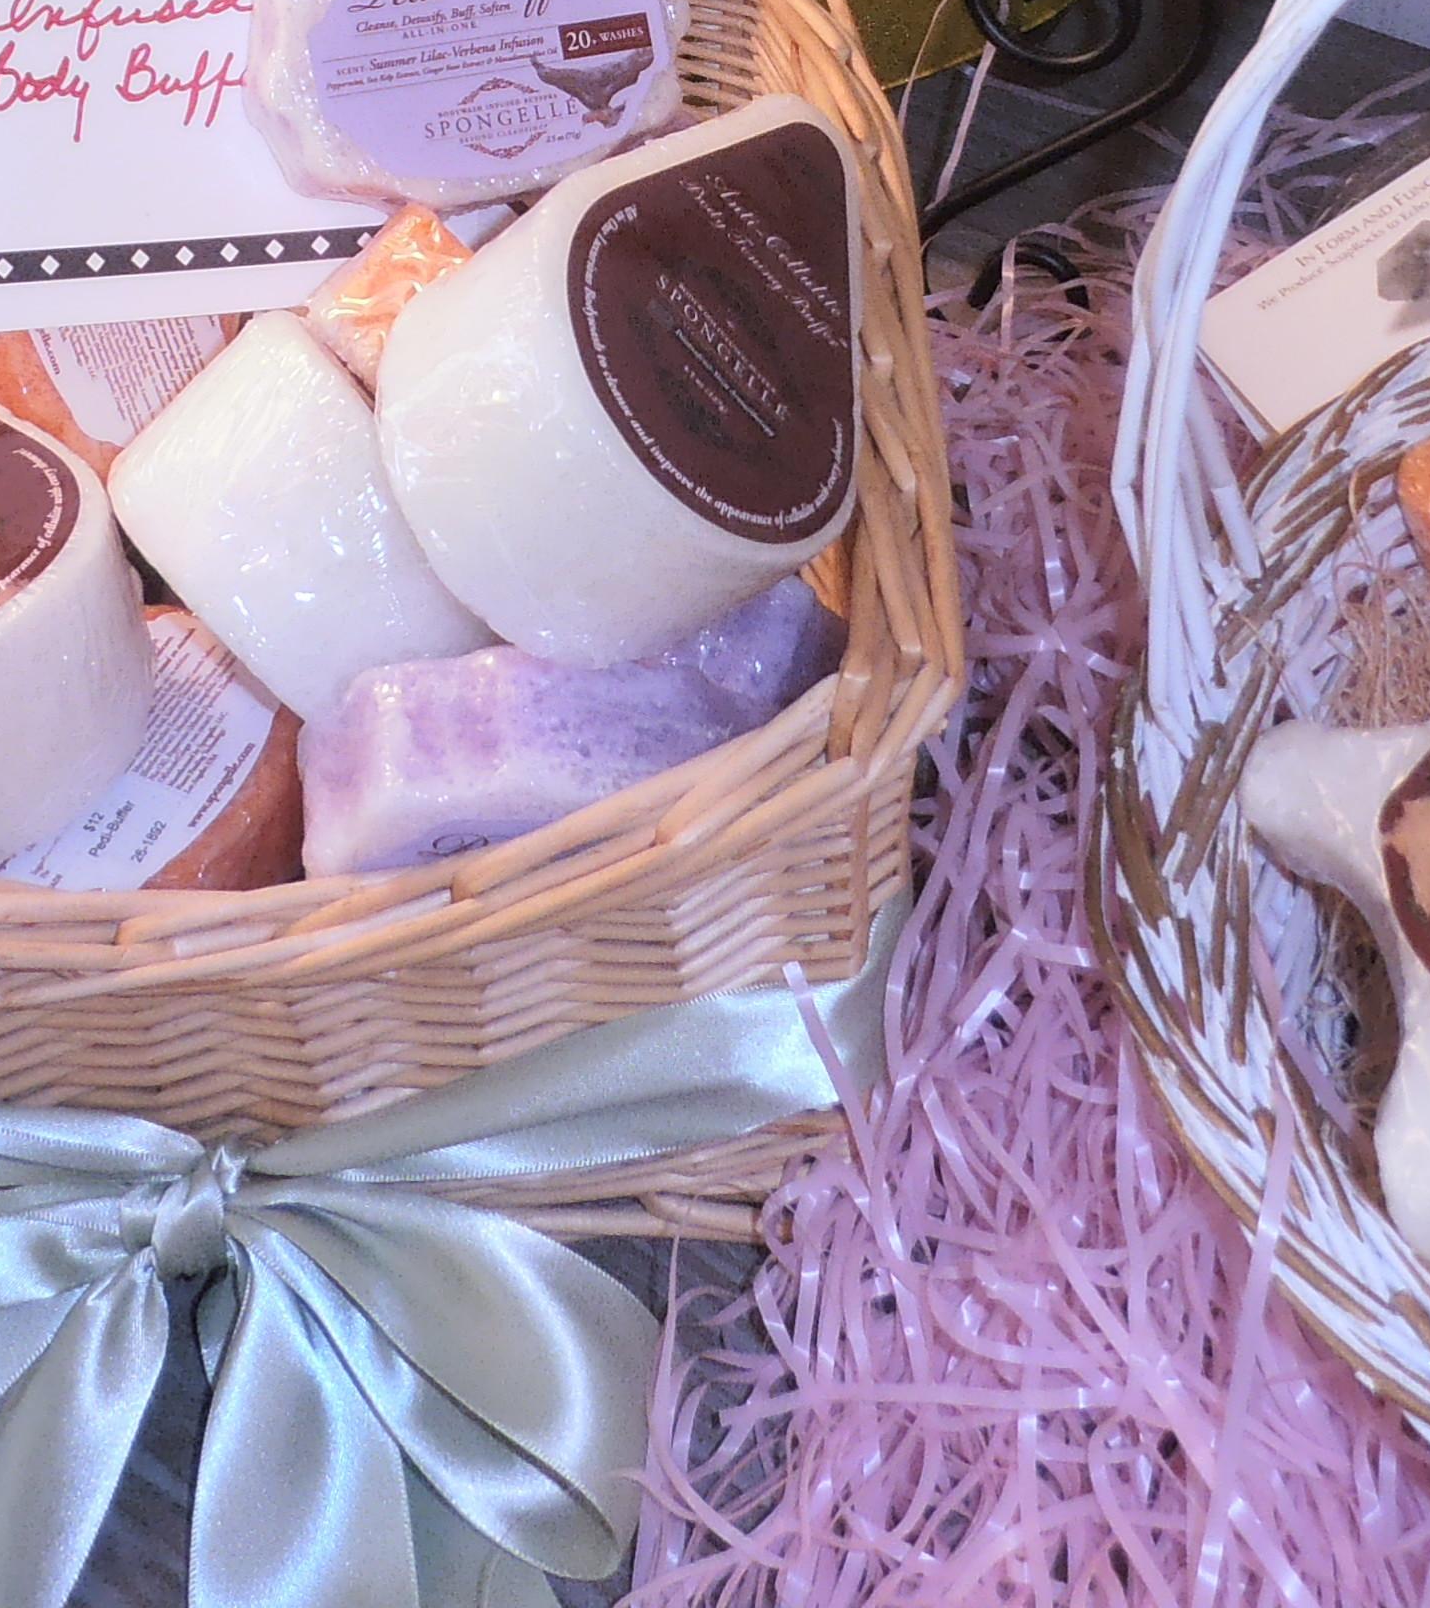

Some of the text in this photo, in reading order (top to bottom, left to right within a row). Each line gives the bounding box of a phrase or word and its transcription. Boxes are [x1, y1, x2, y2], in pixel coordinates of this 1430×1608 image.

[369, 54, 417, 71] Summer
[420, 39, 497, 63] Lilac-Verbena
[499, 33, 545, 51] Infusion
[598, 24, 644, 43] WASHES
[1314, 220, 1360, 256] FORM
[1359, 202, 1393, 229] AND
[82, 811, 105, 834] $12
[88, 800, 136, 858] Pedi-Buffer
